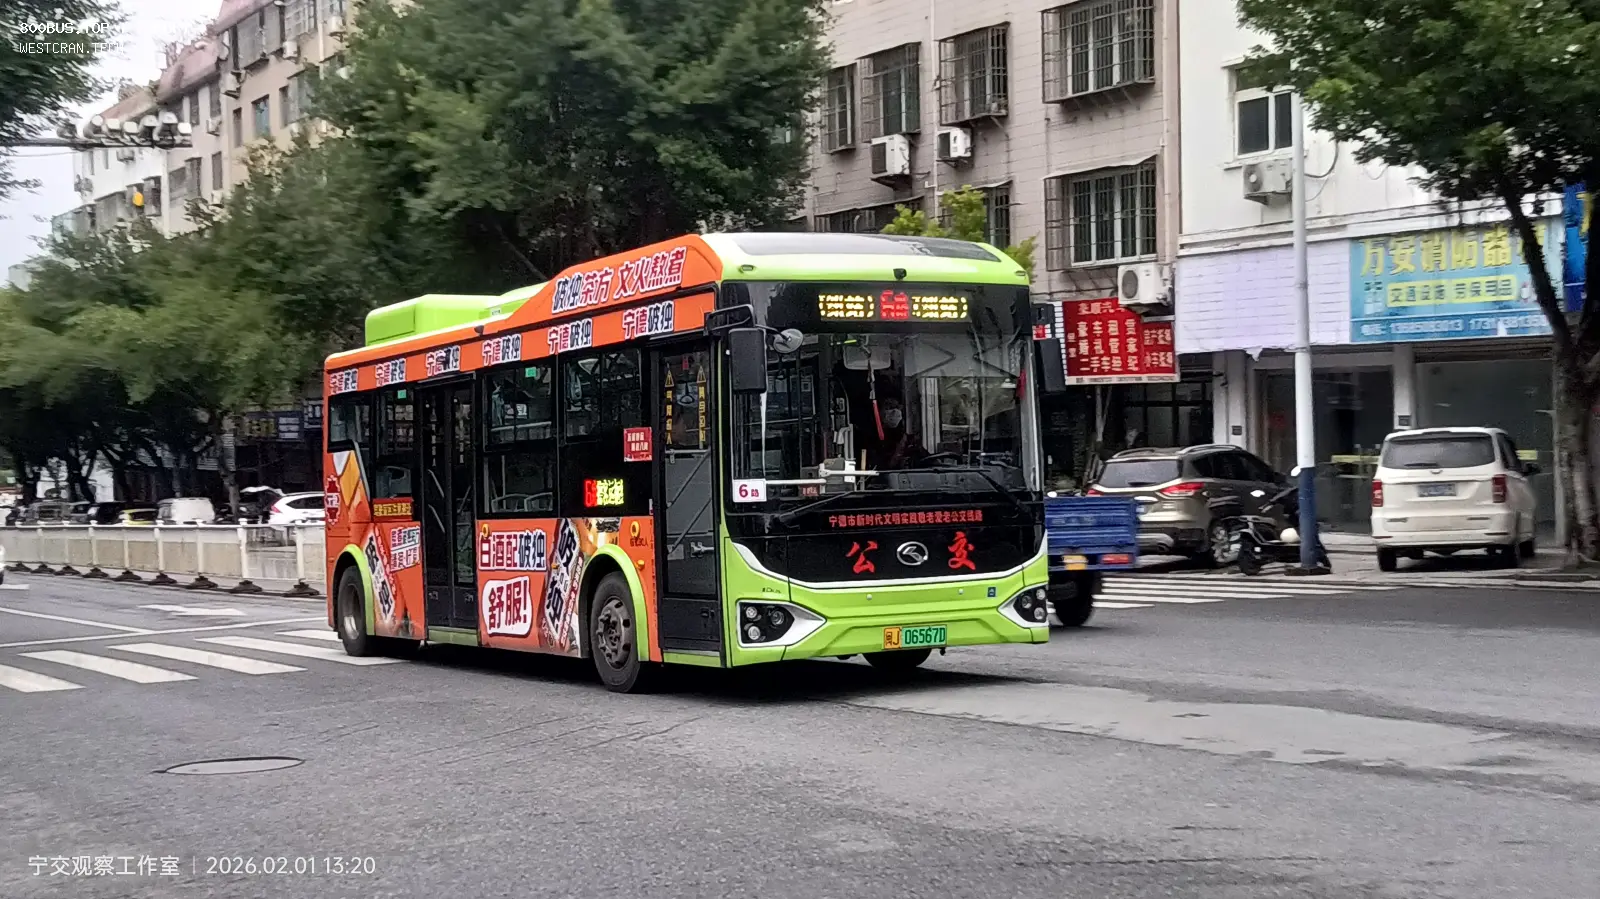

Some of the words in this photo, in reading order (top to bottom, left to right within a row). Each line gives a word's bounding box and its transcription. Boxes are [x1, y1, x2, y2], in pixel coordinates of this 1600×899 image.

[552, 268, 614, 313] 破独茶方
[613, 246, 686, 299] 文火熬煮
[547, 318, 593, 355] 宁德破独
[622, 300, 674, 340] 宁德破独
[482, 334, 521, 367] 宁德破独
[845, 540, 878, 574] 公
[948, 531, 977, 571] 交
[904, 627, 946, 645] 06567D
